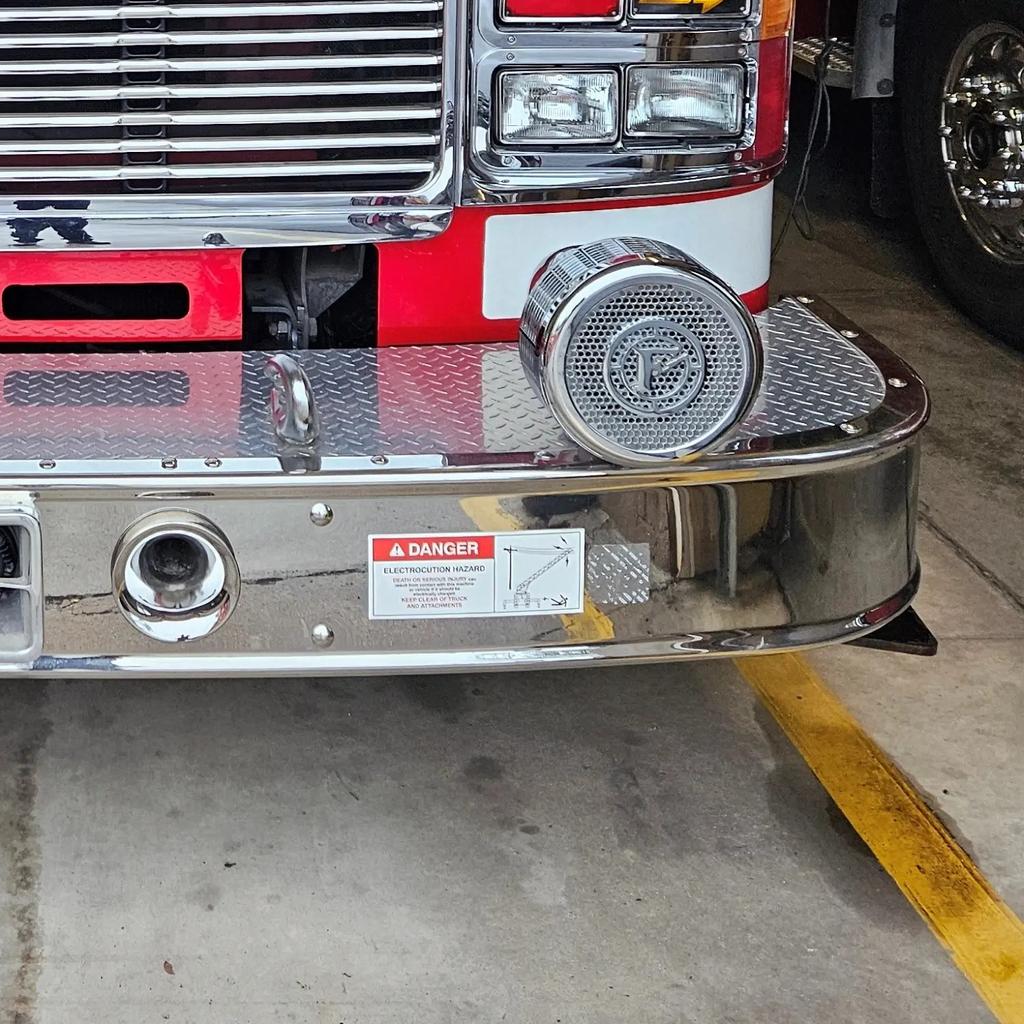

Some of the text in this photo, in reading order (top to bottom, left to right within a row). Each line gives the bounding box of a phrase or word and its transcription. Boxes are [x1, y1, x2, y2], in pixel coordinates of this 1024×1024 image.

[408, 541, 479, 557] DANGER
[383, 565, 486, 574] ELECTROCUTION HAZARD
